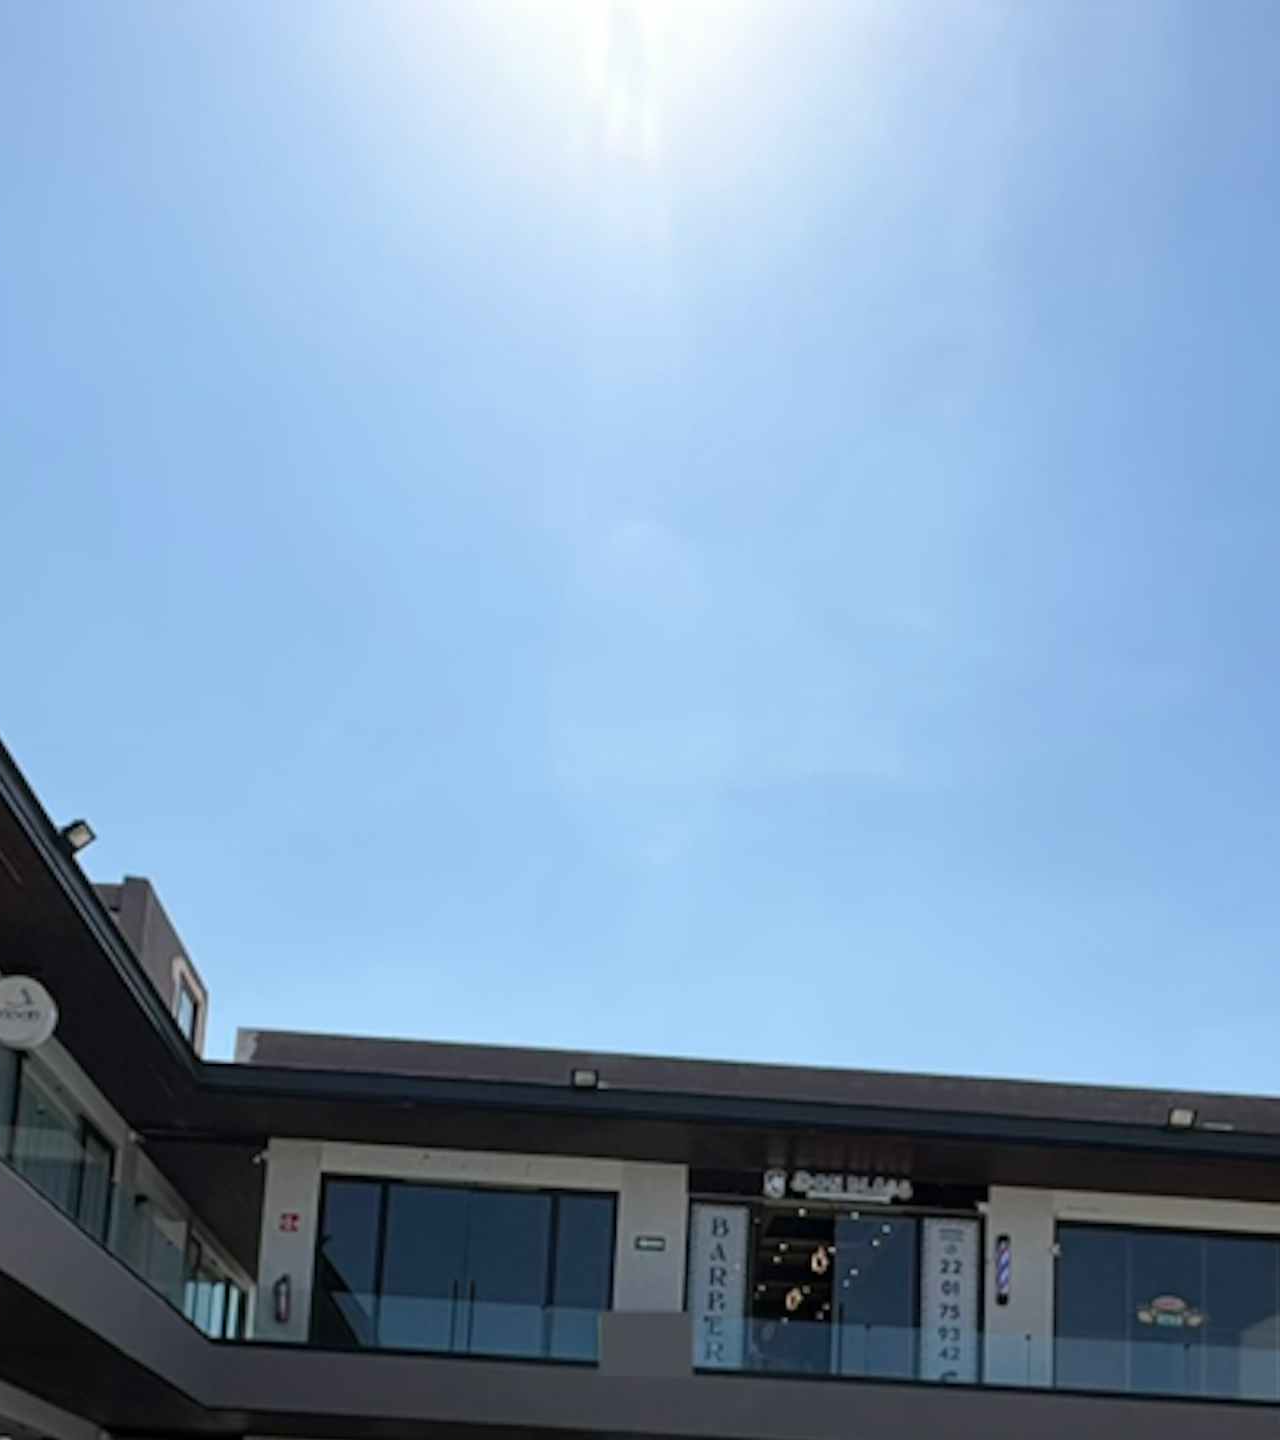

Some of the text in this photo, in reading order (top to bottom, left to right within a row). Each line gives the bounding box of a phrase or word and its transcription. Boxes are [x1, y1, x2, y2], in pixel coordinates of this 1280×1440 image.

[940, 1259, 962, 1274] 22
[941, 1280, 961, 1295] 01
[940, 1304, 960, 1319] 75
[938, 1327, 960, 1342] 93
[938, 1346, 960, 1360] 42
